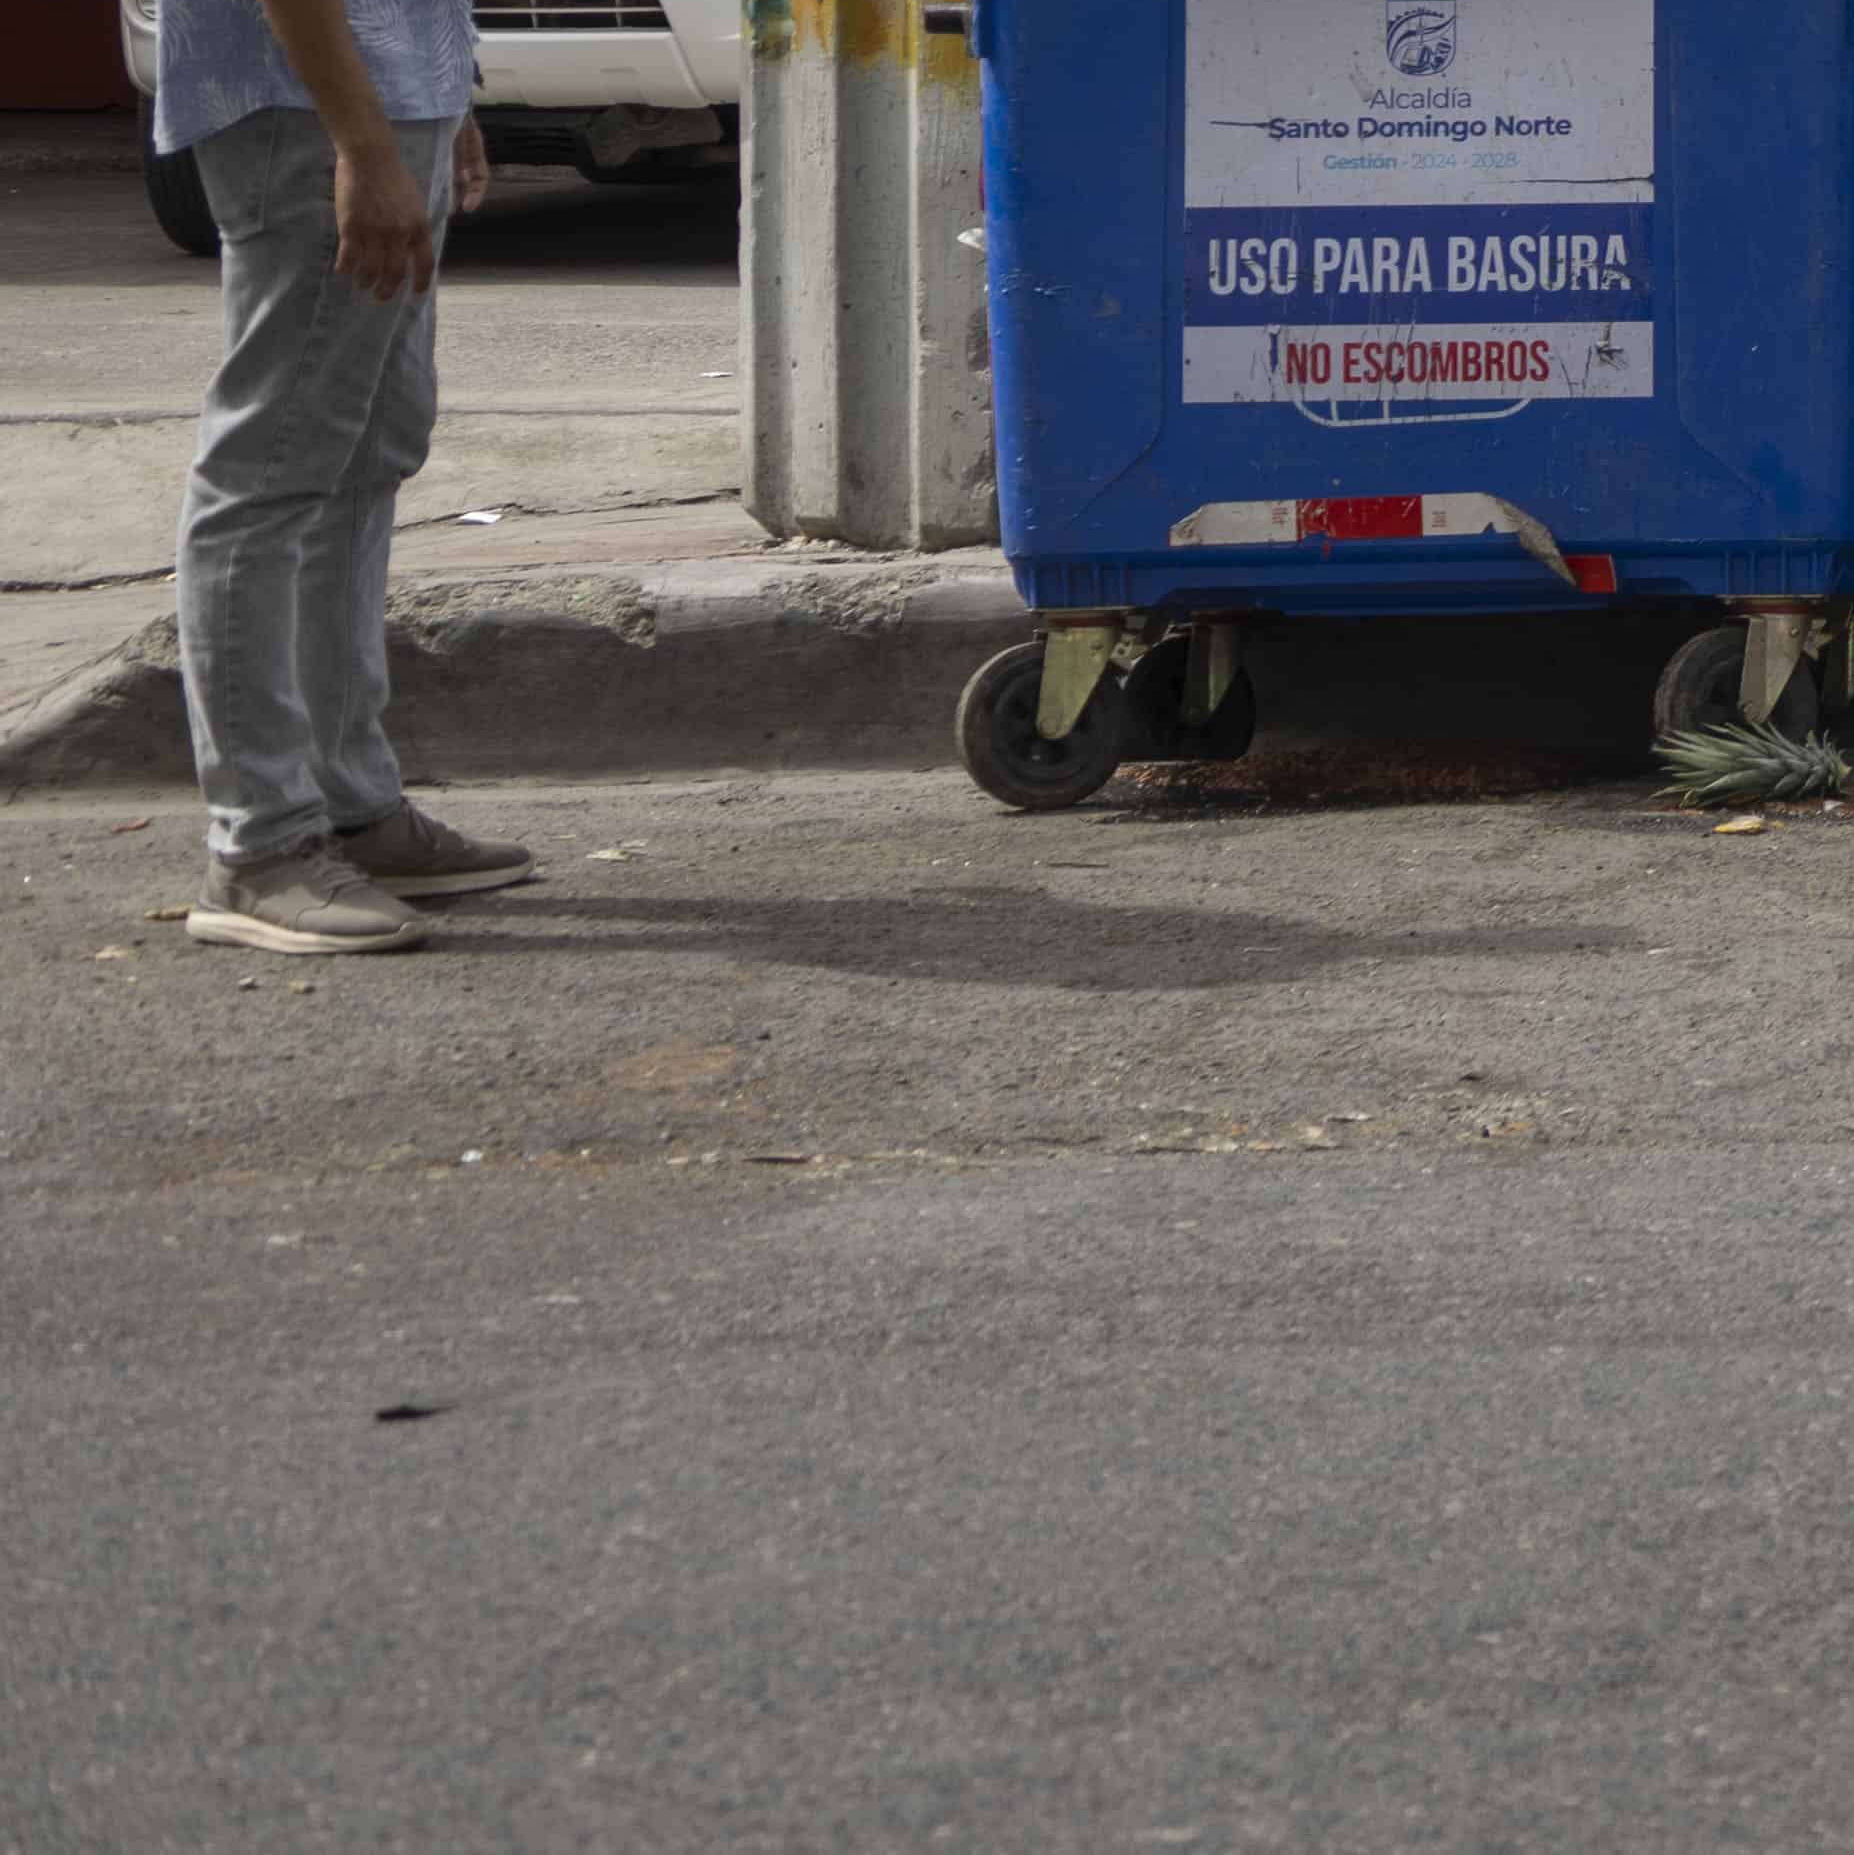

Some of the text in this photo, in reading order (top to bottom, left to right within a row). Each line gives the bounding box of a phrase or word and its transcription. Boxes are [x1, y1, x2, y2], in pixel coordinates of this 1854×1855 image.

[1369, 87, 1473, 110] Alcaldía
[1268, 115, 1572, 142] Santo Domingo Norte
[1323, 152, 1519, 170] Gestión 2024 2028
[1208, 234, 1632, 296] USO PARA BASURA
[1285, 339, 1550, 385] NO ESCOMBROS
